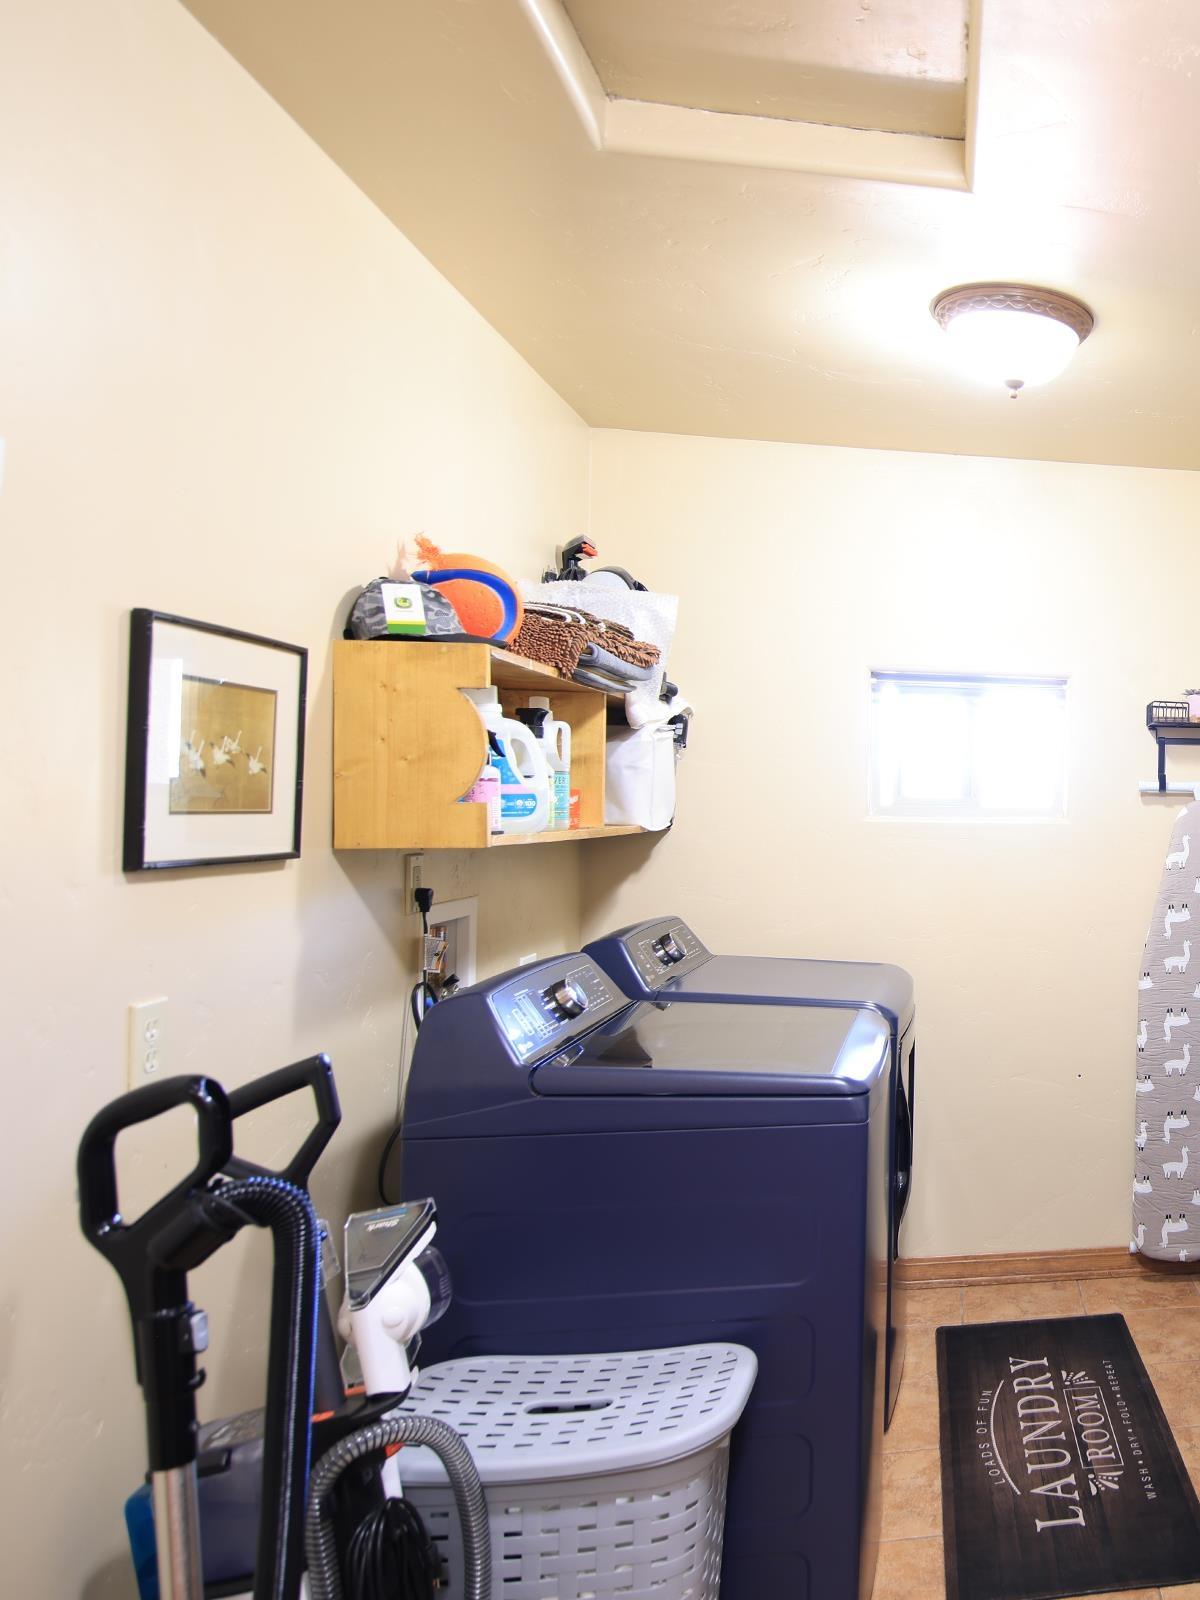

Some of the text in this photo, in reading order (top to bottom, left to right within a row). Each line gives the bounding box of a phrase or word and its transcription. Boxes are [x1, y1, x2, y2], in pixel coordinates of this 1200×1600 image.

[976, 1390, 1006, 1485] LOADS OF FUN
[1009, 1356, 1086, 1533] LAUNDRY
[1071, 1393, 1116, 1463] ROOM
[1102, 1359, 1158, 1500] WASH DRY FOLD REPEAT
